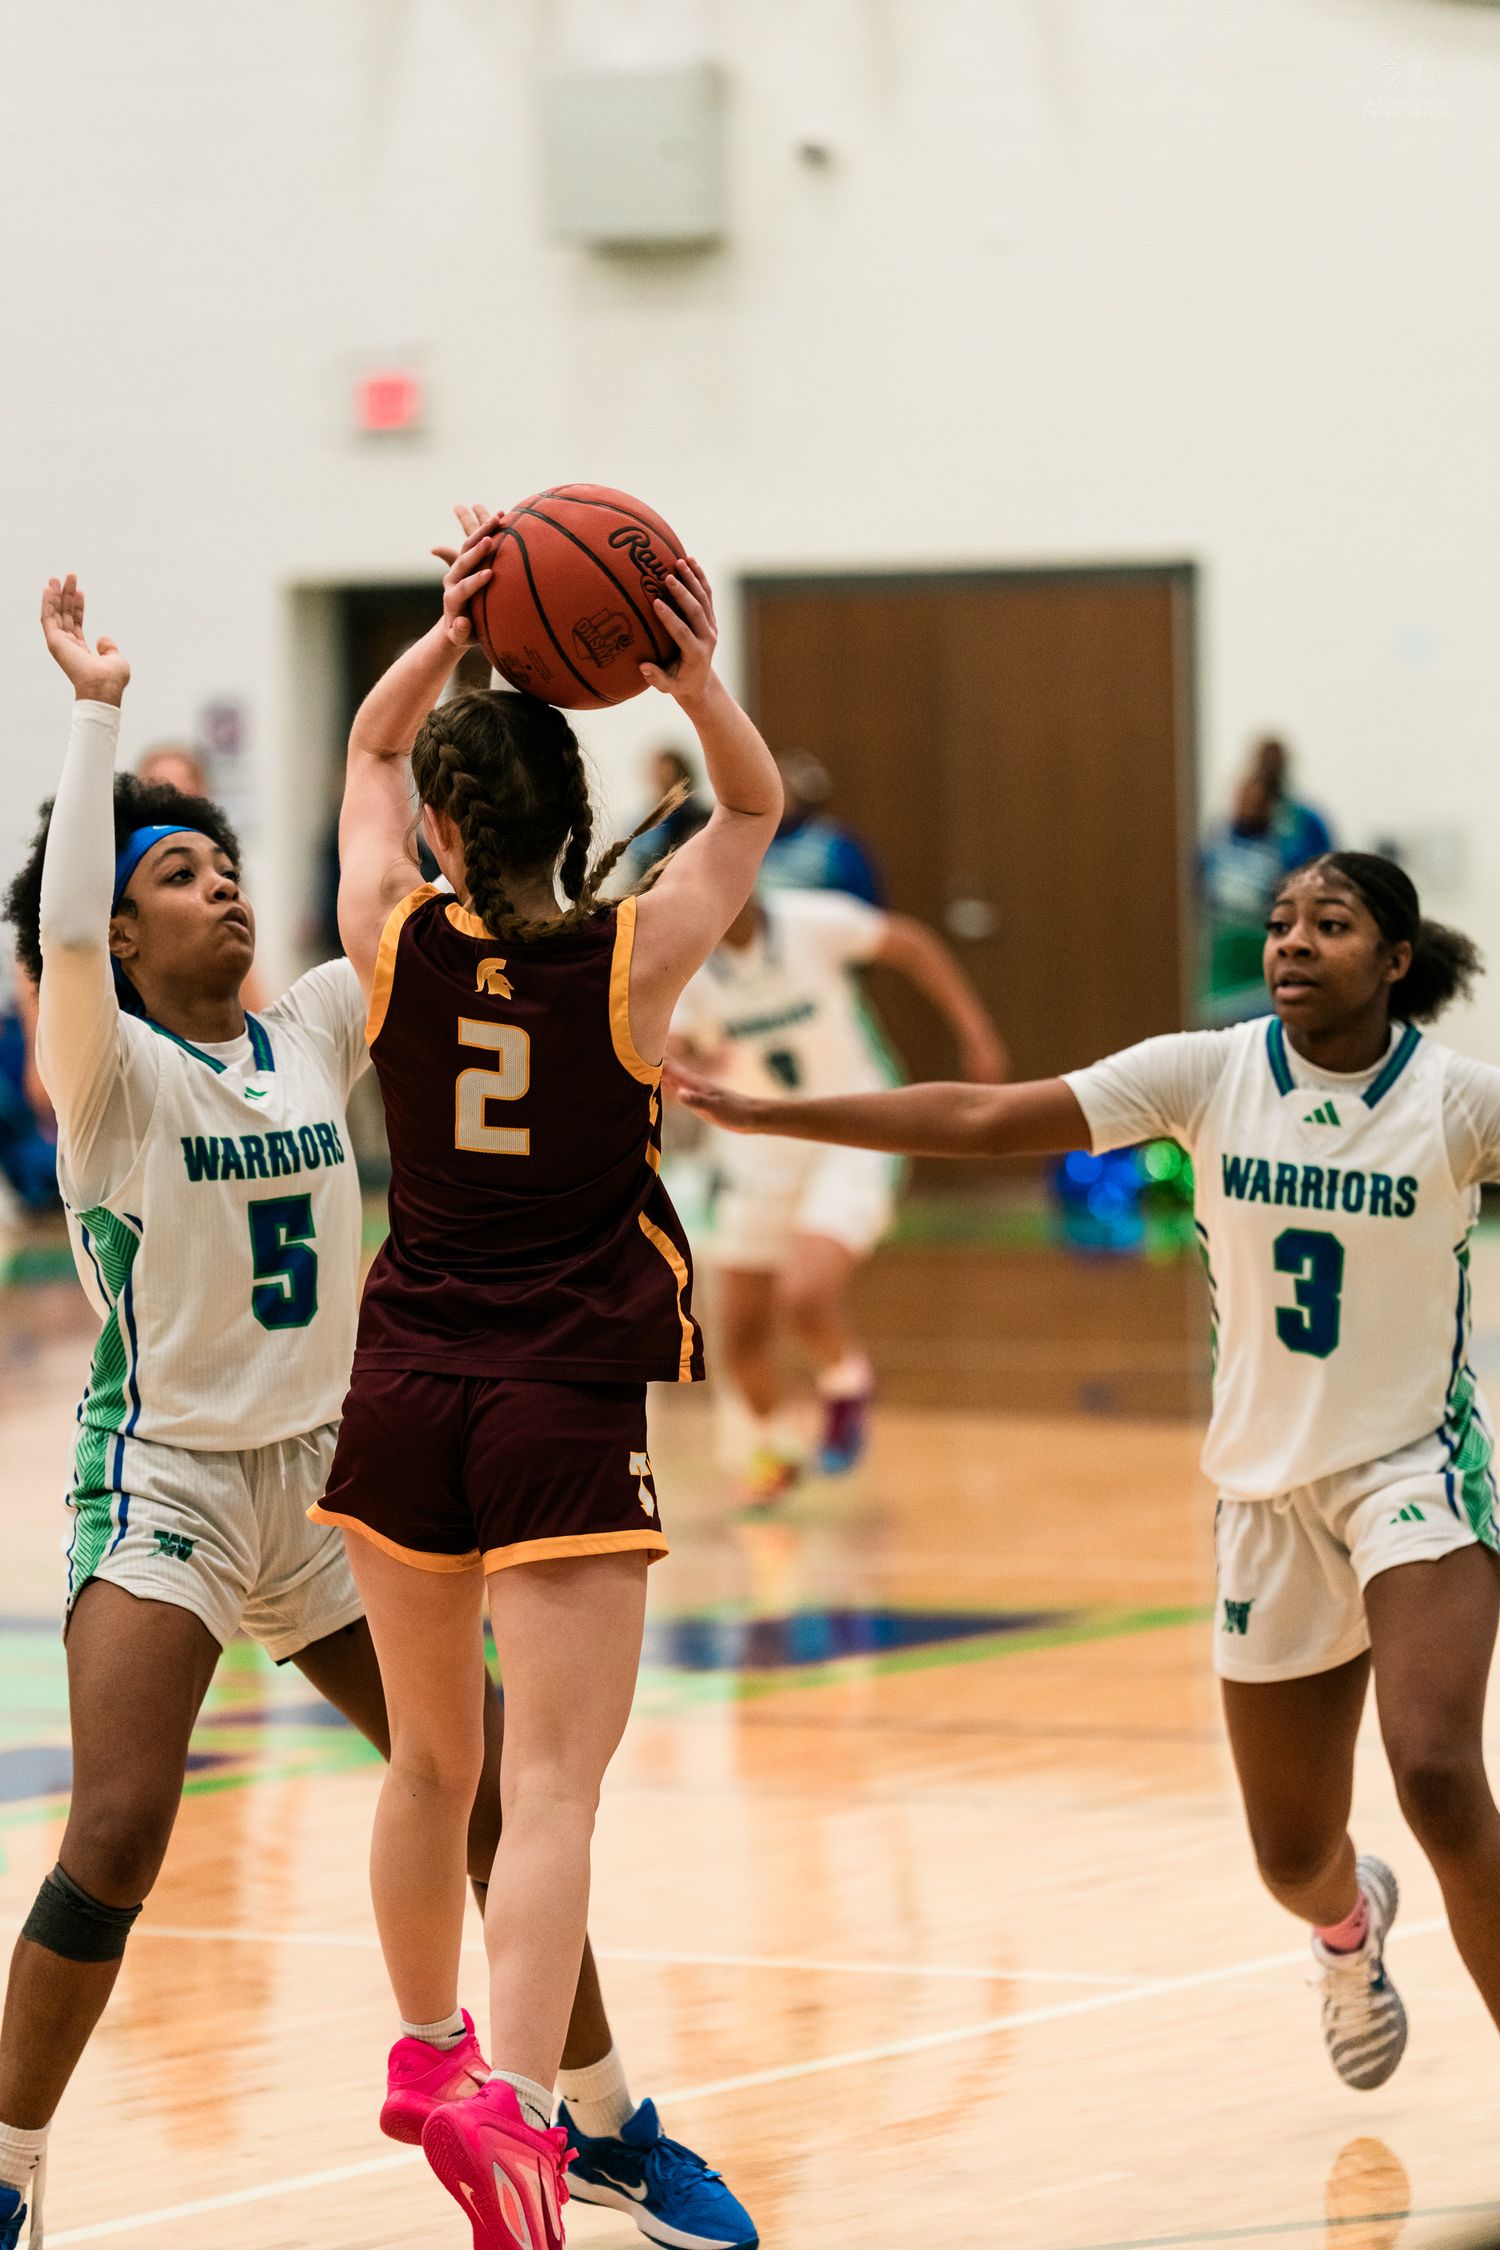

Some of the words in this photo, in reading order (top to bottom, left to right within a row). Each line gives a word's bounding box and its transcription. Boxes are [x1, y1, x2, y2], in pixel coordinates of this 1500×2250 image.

[608, 526, 671, 581] Raw
[455, 1017, 530, 1155] 2
[180, 1120, 345, 1182] WARRIORS
[1222, 1154, 1418, 1218] WARRIORS
[248, 1193, 318, 1331] 5
[1272, 1227, 1345, 1359] 3
